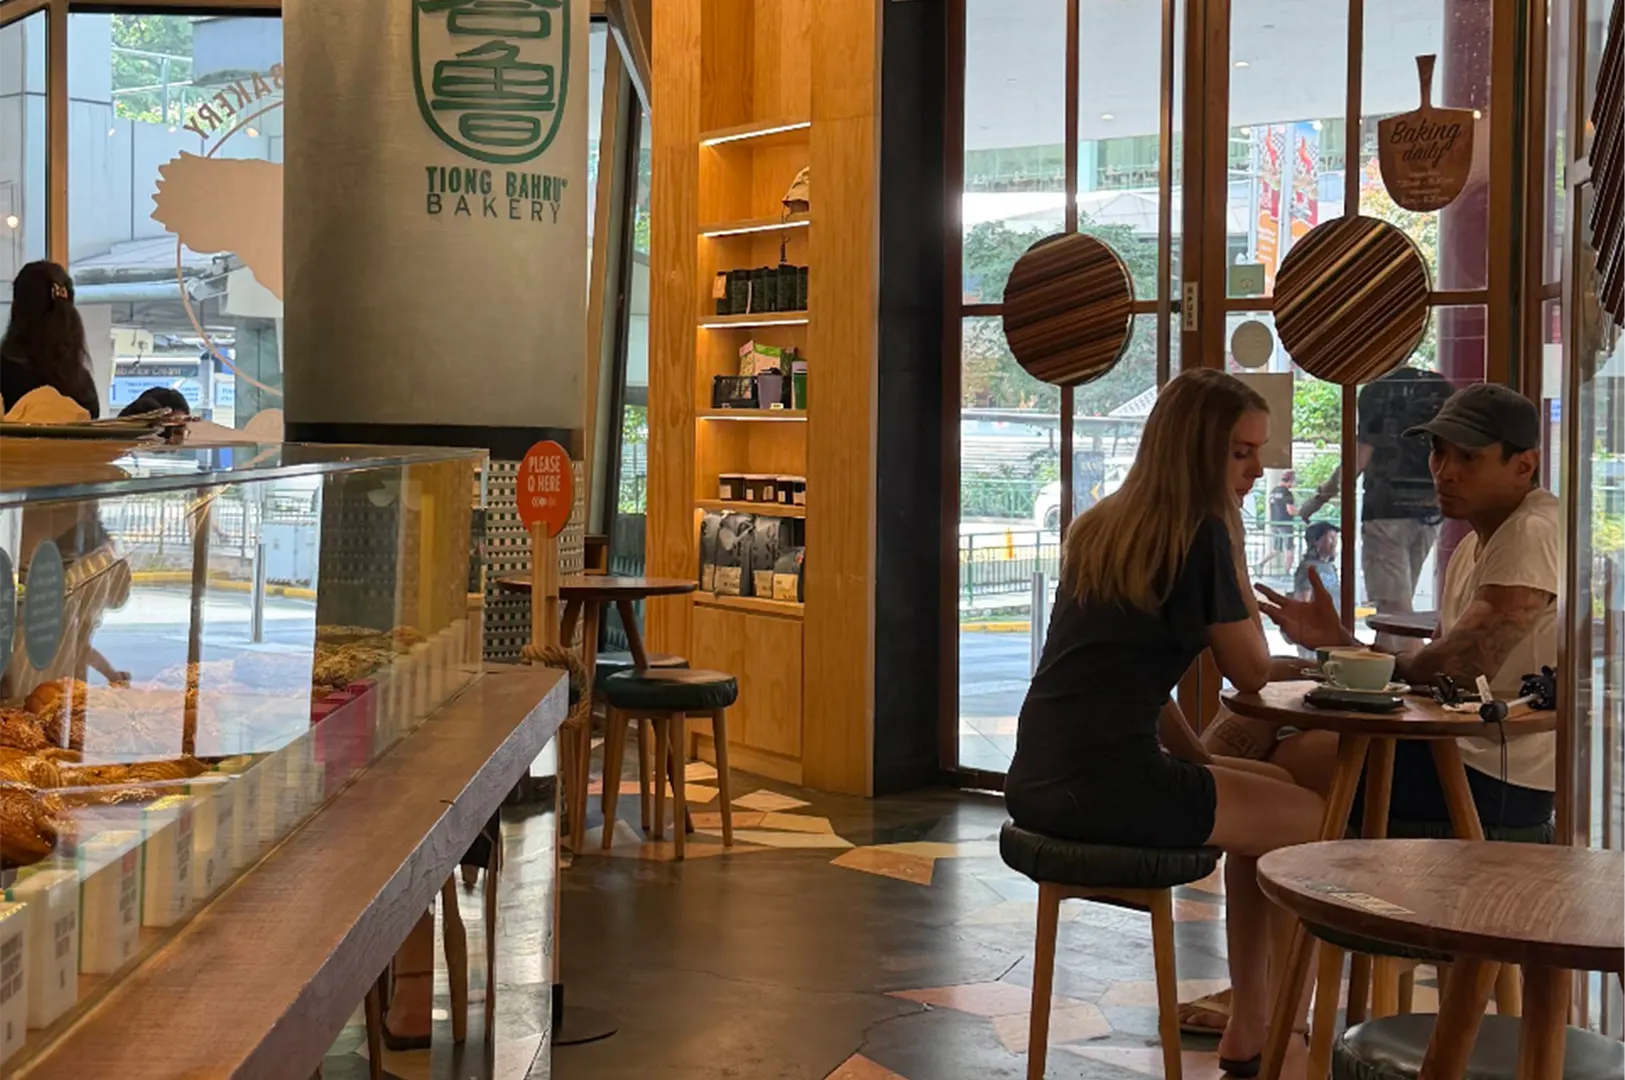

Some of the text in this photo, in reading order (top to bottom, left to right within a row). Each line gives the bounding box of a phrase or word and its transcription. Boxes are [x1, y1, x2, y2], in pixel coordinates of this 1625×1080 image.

[1390, 118, 1461, 151] Baking
[1402, 141, 1447, 168] daily
[425, 166, 492, 195] TIONG
[427, 193, 561, 224] BAKERY
[528, 455, 561, 473] PLEASE
[537, 475, 561, 492] HERE
